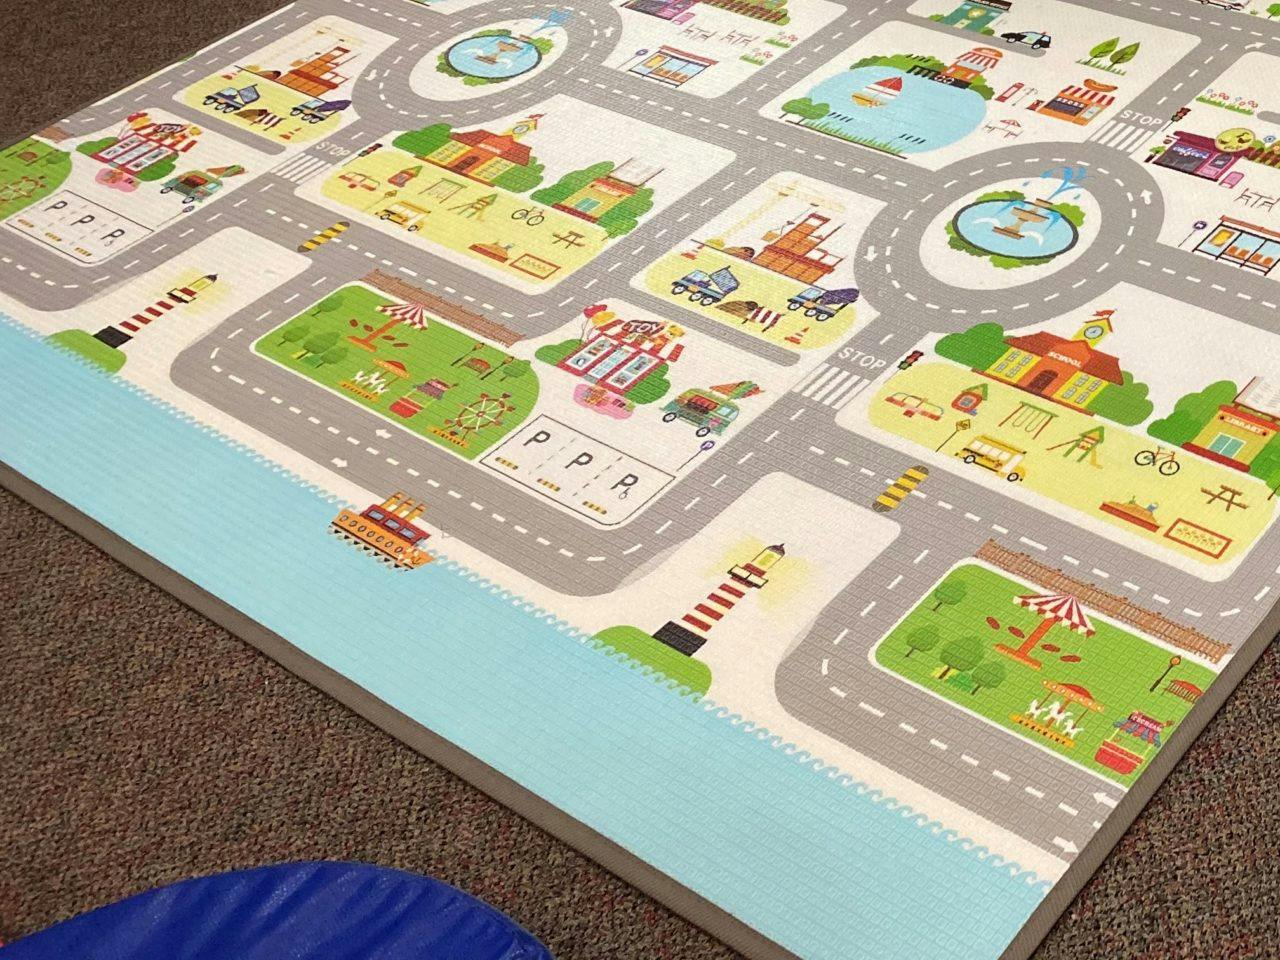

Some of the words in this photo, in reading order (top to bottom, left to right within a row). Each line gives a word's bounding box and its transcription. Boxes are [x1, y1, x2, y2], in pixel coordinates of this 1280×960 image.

[1120, 109, 1163, 127] STOP
[316, 141, 351, 157] STOP
[44, 200, 68, 212] P
[70, 214, 96, 226] P
[100, 228, 126, 241] P
[628, 321, 666, 334] TOY
[838, 347, 887, 370] STOP
[1047, 351, 1082, 369] SCHOOL
[522, 430, 551, 446] P
[564, 452, 594, 469] P
[610, 473, 639, 490] P
